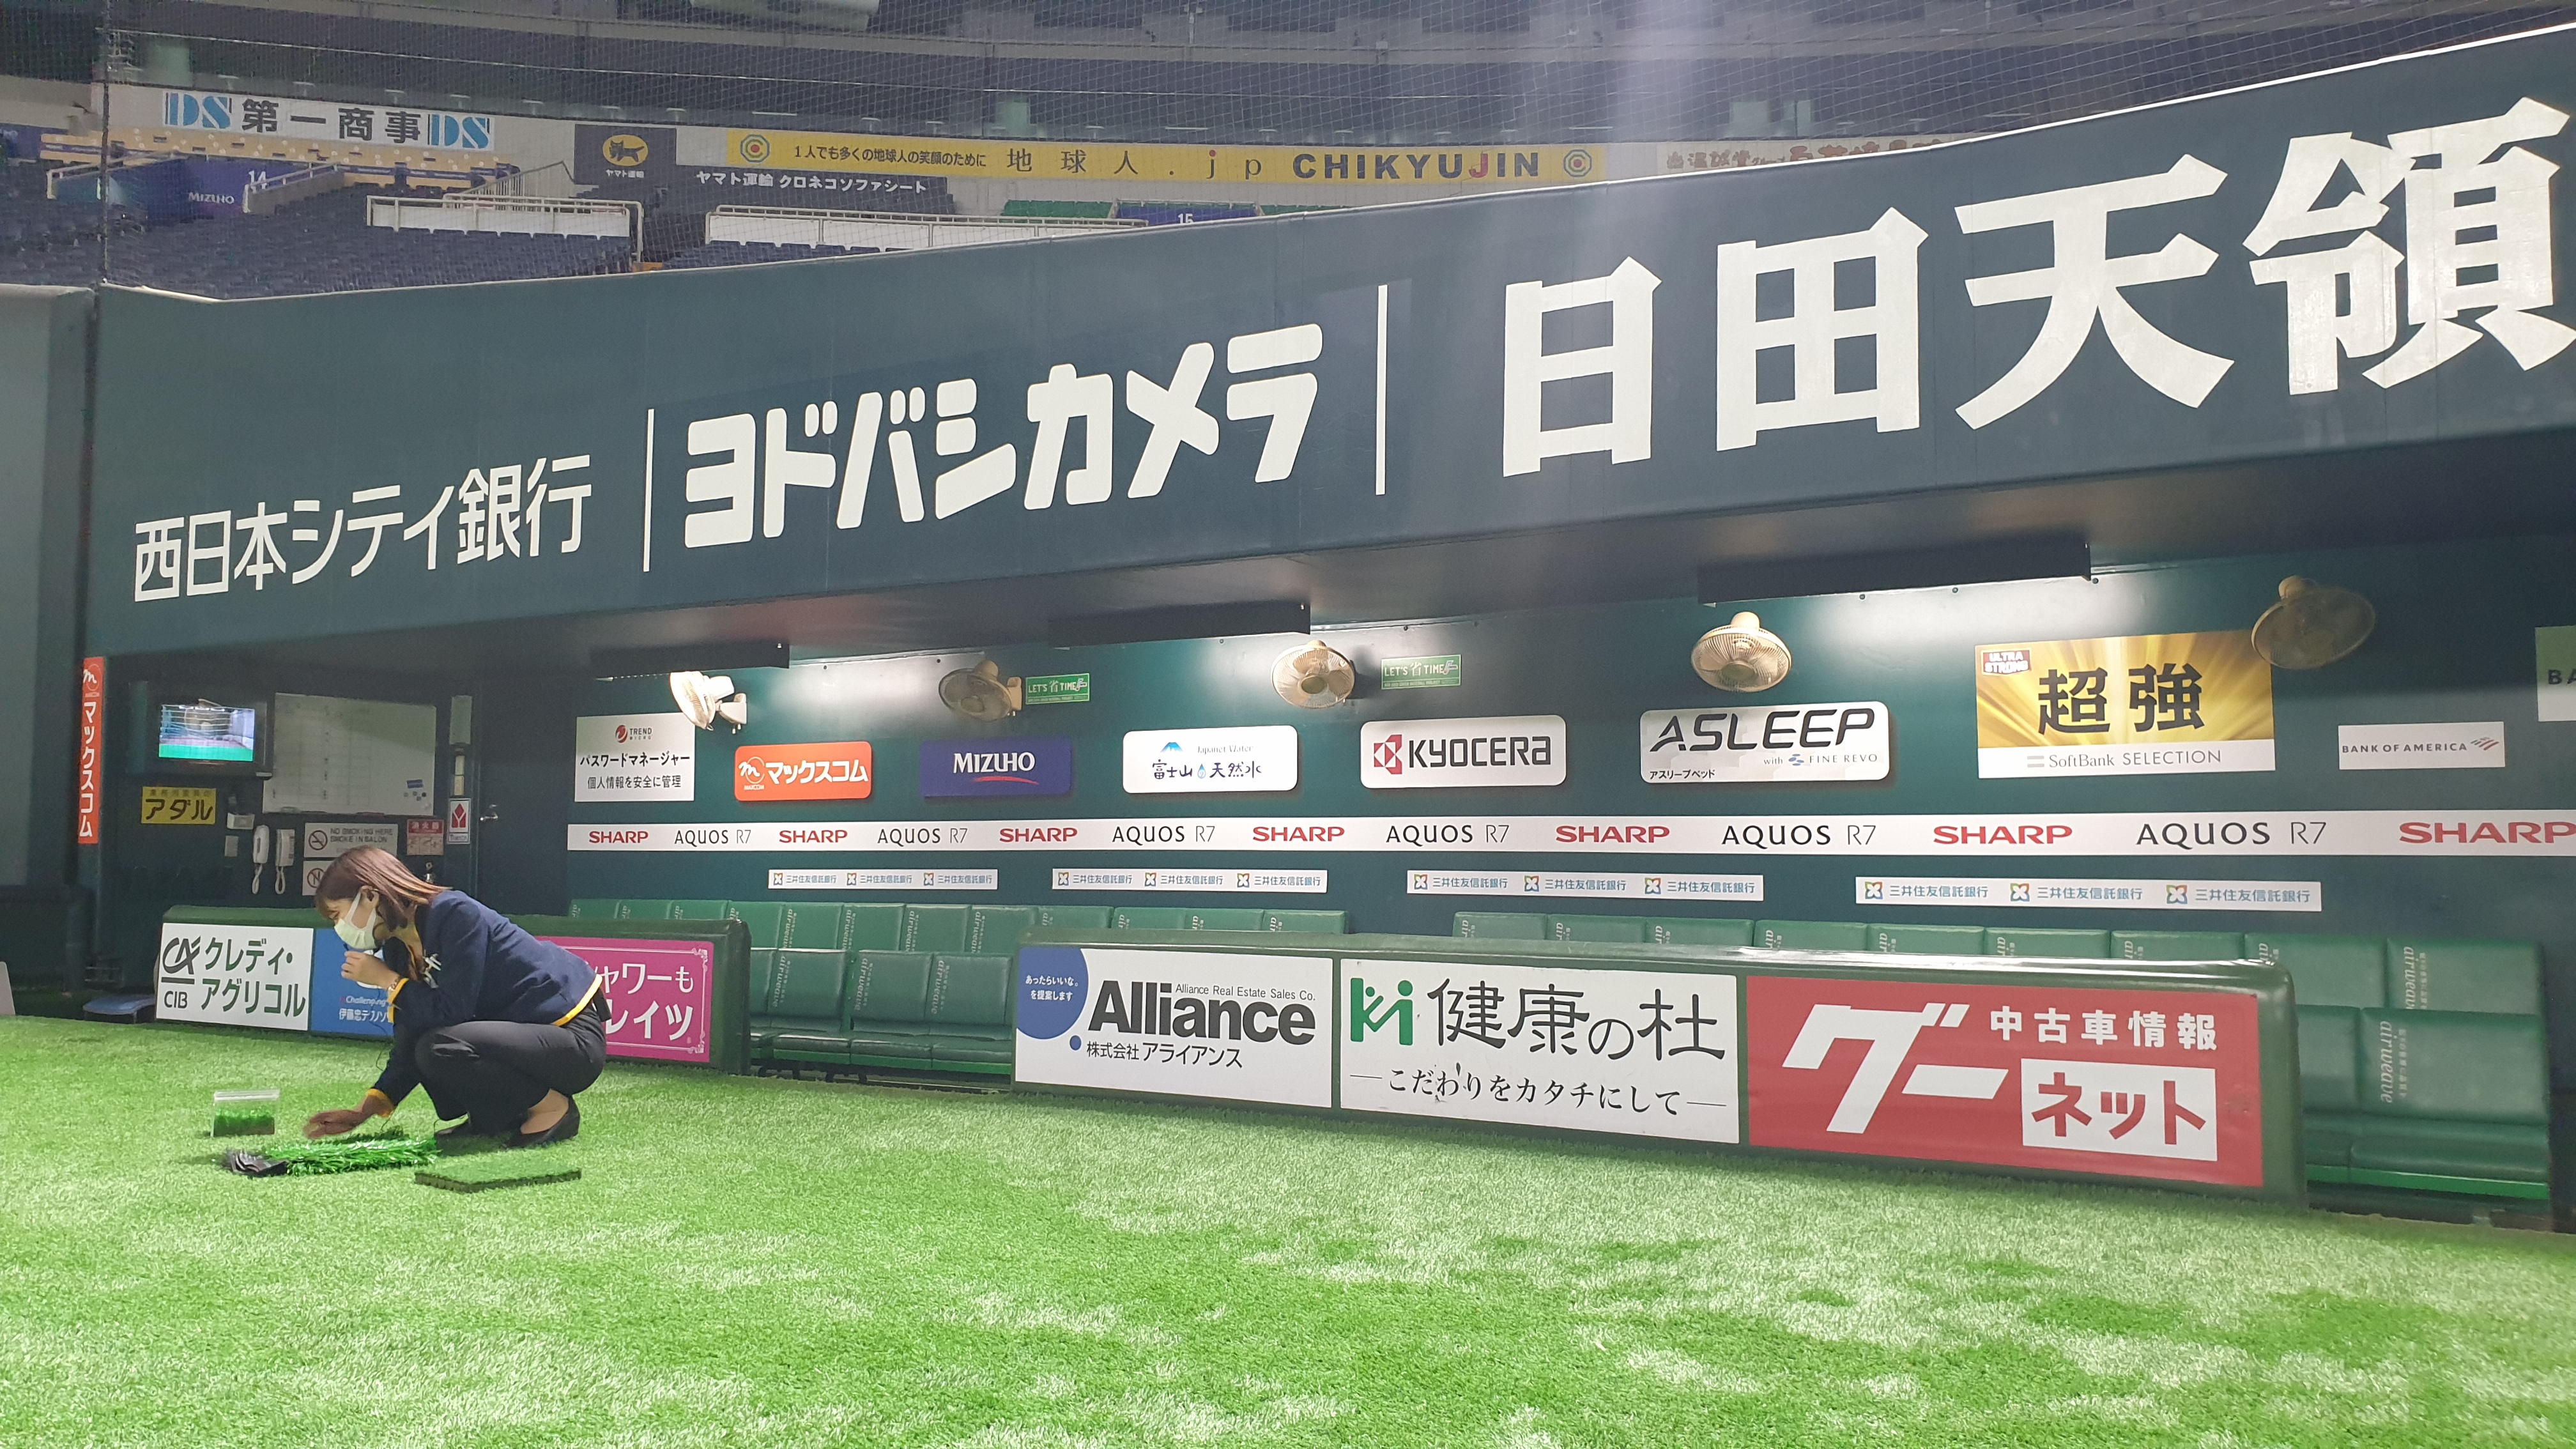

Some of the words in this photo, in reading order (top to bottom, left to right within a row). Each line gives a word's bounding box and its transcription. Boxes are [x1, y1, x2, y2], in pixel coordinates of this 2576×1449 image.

[243, 100, 421, 144] 第一商事
[1293, 152, 1538, 180] CHIKYUJIN
[696, 171, 774, 187] ヤマト運輸
[779, 174, 926, 194] クロネコソファシート
[1178, 213, 1193, 224] 15
[1503, 96, 2576, 477] 日田天領
[685, 323, 1322, 548] ヨドバシカメラ
[1985, 661, 2028, 673] STRONG
[1989, 652, 2023, 661] ULTRA
[1384, 666, 1408, 677] LET'S
[1423, 664, 1444, 675] TIME
[1029, 684, 1048, 693] LET'S
[1060, 682, 1077, 691] TIME
[2038, 663, 2205, 736] 超強
[1650, 708, 1874, 752] ASLEEP
[580, 751, 690, 767] パスワードマネージャー
[1198, 746, 1225, 755] Japanet
[1409, 736, 1551, 768] KYOCERA
[1764, 756, 1782, 765] with
[1809, 755, 1837, 763] FINE
[1844, 754, 1878, 762] REVO
[2049, 753, 2115, 768] SoftBank
[2122, 749, 2222, 766] SELECTION
[2342, 744, 2379, 754] BANK
[2383, 744, 2400, 753] OF
[2403, 742, 2467, 753] AMERICA
[79, 702, 96, 837] マックスコム
[765, 759, 868, 785] マックスコム
[953, 751, 1036, 774] MIZUHO
[1650, 769, 1715, 779] アスリープベッド
[588, 775, 681, 789] 個人情報を安全に管理
[146, 799, 213, 820] アダル
[589, 831, 648, 844] SHARP
[674, 830, 728, 847] AQUOS
[736, 829, 751, 843] R7
[779, 830, 848, 843] SHARP
[878, 829, 941, 846] AQUOS
[950, 828, 967, 843] R7
[999, 828, 1078, 843] SHARP
[1112, 825, 1185, 845] AQUOS
[1195, 825, 1215, 842] R7
[1253, 826, 1345, 842] SHARP
[1386, 825, 1473, 846] AQUOS
[1485, 825, 1509, 843] R7
[1556, 825, 1669, 843] SHARP
[1722, 825, 1831, 848] AQUOS
[1847, 825, 1876, 845] R7
[1933, 825, 2072, 845] SHARP
[2136, 822, 2270, 850] AQUOS
[2290, 822, 2326, 845] R7
[2399, 822, 2576, 844] SHARP
[786, 874, 836, 884] 三井住友信託銀行
[860, 874, 912, 884] 三井住友信託銀行
[937, 874, 992, 885] 三井住友信託銀行
[1072, 874, 1132, 885] 三井住友信託銀行
[1160, 874, 1223, 885] 三井住友信託銀行
[1254, 875, 1321, 887] 三井住友信託銀行
[1432, 877, 1508, 889] 三井住友信託銀行
[1545, 878, 1626, 891] 三井住友信託銀行
[1667, 881, 1755, 893] 三井住友信託銀行
[1889, 884, 1988, 898] 三井住友信託銀行
[2037, 887, 2142, 900] 三井住友信託銀行
[2195, 888, 2310, 902] 三井住友信託銀行
[783, 908, 793, 948] airweav
[842, 909, 852, 950] airweav
[905, 910, 916, 953] airweav
[971, 911, 982, 953] airweav
[595, 963, 693, 994] ャワーも
[854, 958, 869, 1011] airweave
[1025, 976, 1079, 987] あったらいいな。
[2404, 946, 2419, 1009] airweav
[164, 991, 188, 1008] CIB
[201, 978, 305, 1017] アグリコル
[1031, 990, 1073, 1002] を提案します
[1176, 984, 1209, 995] Alliance
[1213, 986, 1233, 995] Real
[1238, 987, 1266, 998] Estate
[1271, 989, 1296, 999] Sales
[1300, 990, 1315, 1000] Co.
[1088, 980, 1315, 1045] Alliance
[1427, 978, 1726, 1061] 健康の杜
[1990, 1006, 2218, 1052] 中古車情報
[1087, 1041, 1139, 1061] 株式会社
[1142, 1042, 1243, 1068] アライアンス
[2380, 1021, 2397, 1103] airweave
[1782, 1003, 2009, 1134] グー
[2032, 1072, 2206, 1145] ネット
